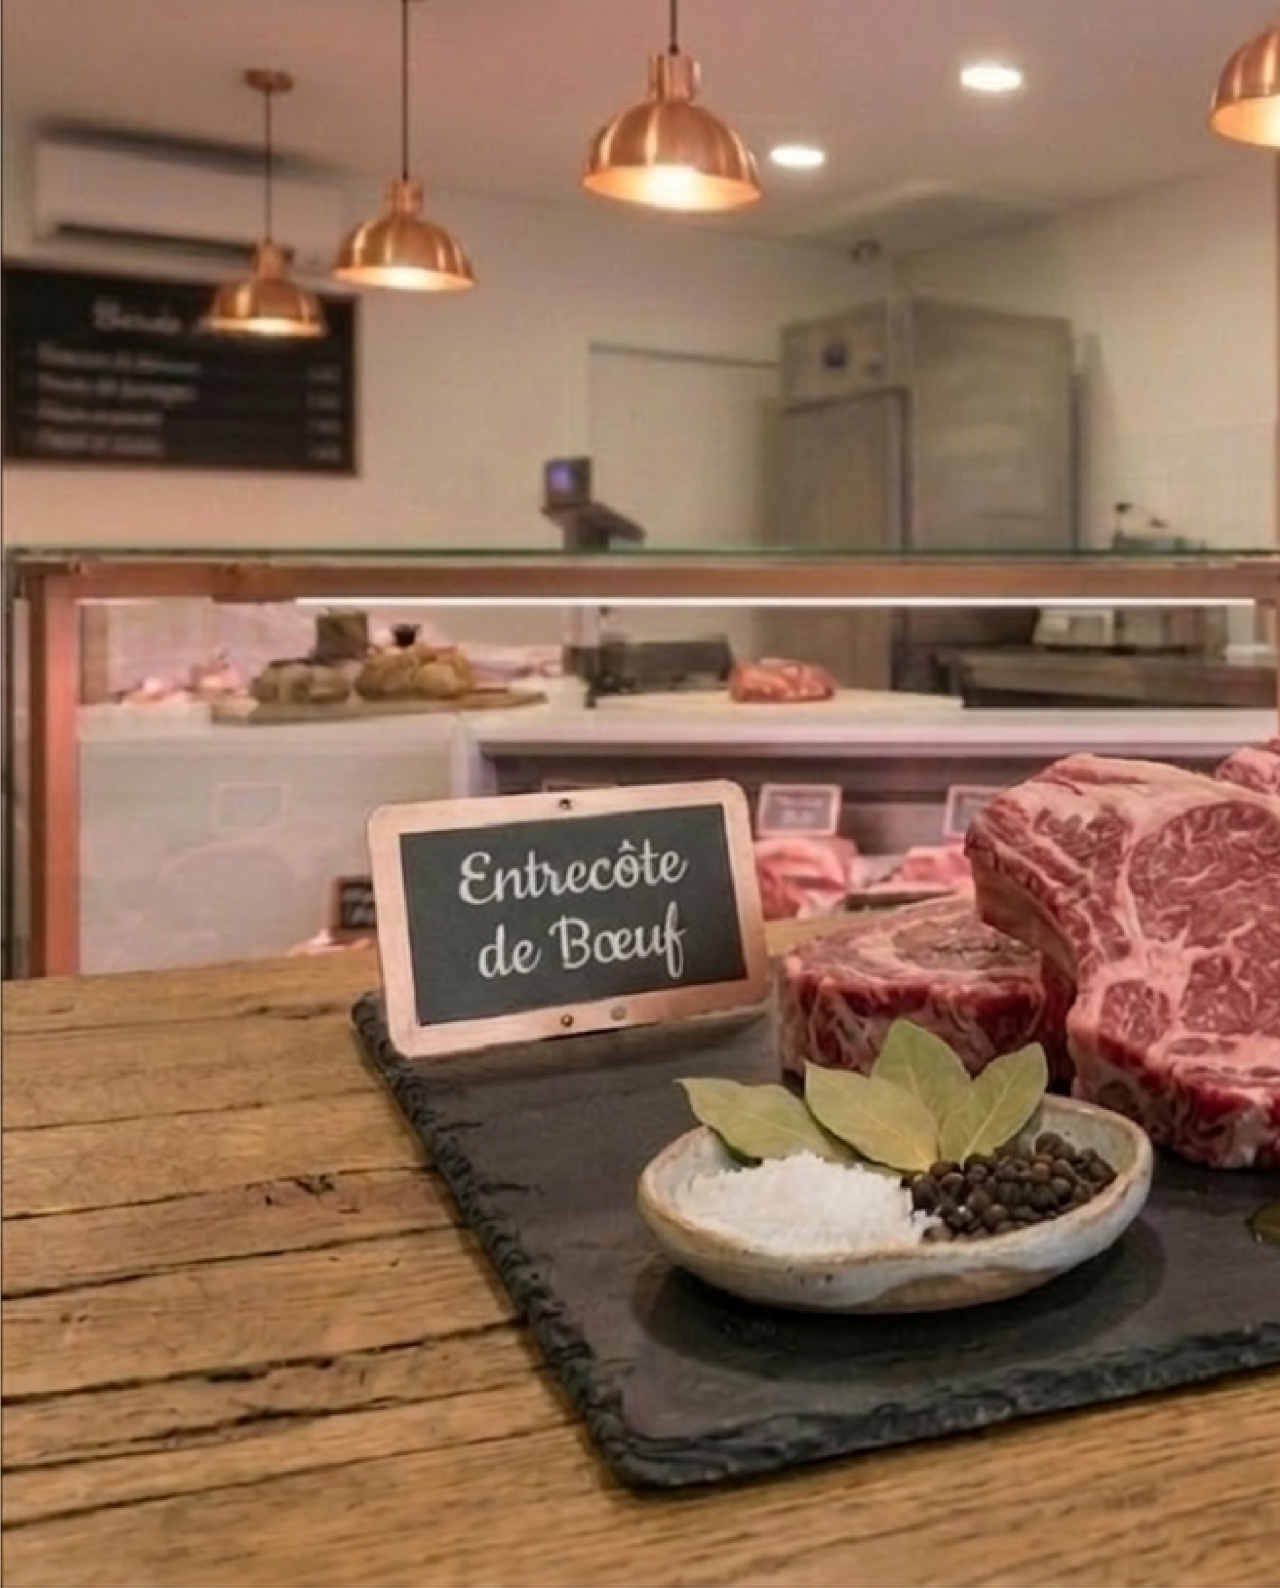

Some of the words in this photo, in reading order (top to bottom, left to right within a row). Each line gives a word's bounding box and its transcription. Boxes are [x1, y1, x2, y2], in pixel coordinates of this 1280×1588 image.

[458, 838, 689, 906] Entrecôte
[478, 923, 542, 980] de
[549, 900, 687, 980] Bœuf
